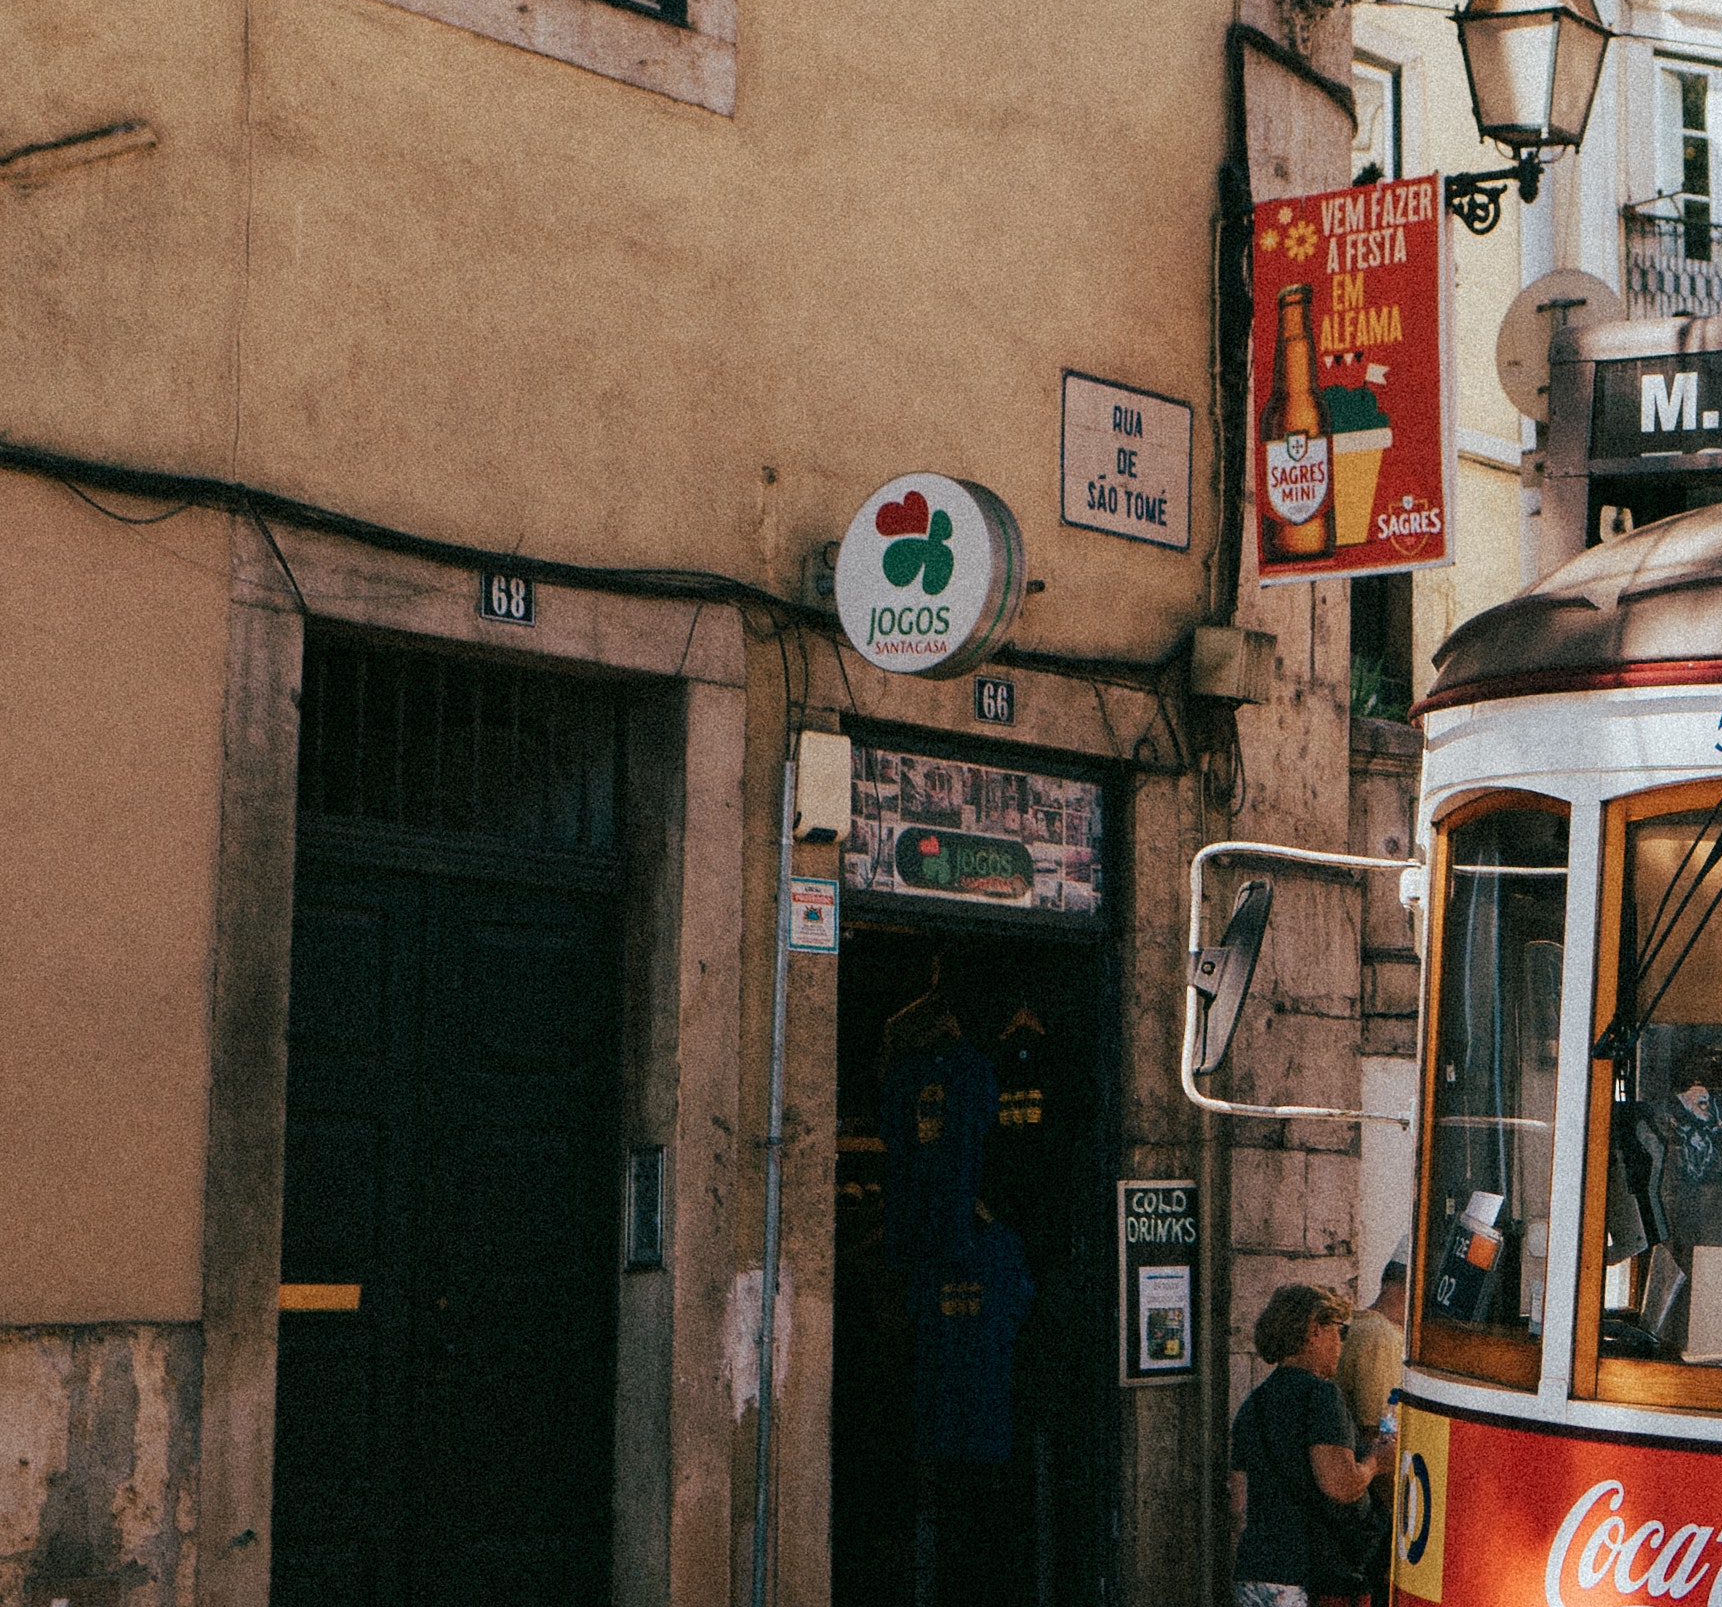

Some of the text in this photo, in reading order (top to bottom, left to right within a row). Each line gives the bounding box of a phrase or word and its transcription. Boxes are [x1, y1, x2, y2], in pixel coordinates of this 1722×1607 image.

[1321, 183, 1433, 237] VEM FAZER
[1326, 227, 1408, 274] A FESTA
[1332, 270, 1365, 311] EM
[1320, 303, 1403, 352] ALFAMA
[1112, 404, 1143, 438] RUA
[1640, 371, 1720, 434] M.
[1117, 447, 1138, 479] DE
[1271, 460, 1325, 488] SAGRES
[1087, 473, 1168, 526] SÃO TOMÉ
[1377, 507, 1442, 539] SAGRES
[491, 574, 526, 619] 68
[866, 605, 951, 646] JOGOS
[982, 682, 1009, 720] 66
[956, 845, 1013, 880] JOGOS
[1132, 1190, 1187, 1213] COLD
[1436, 1274, 1456, 1307] 02
